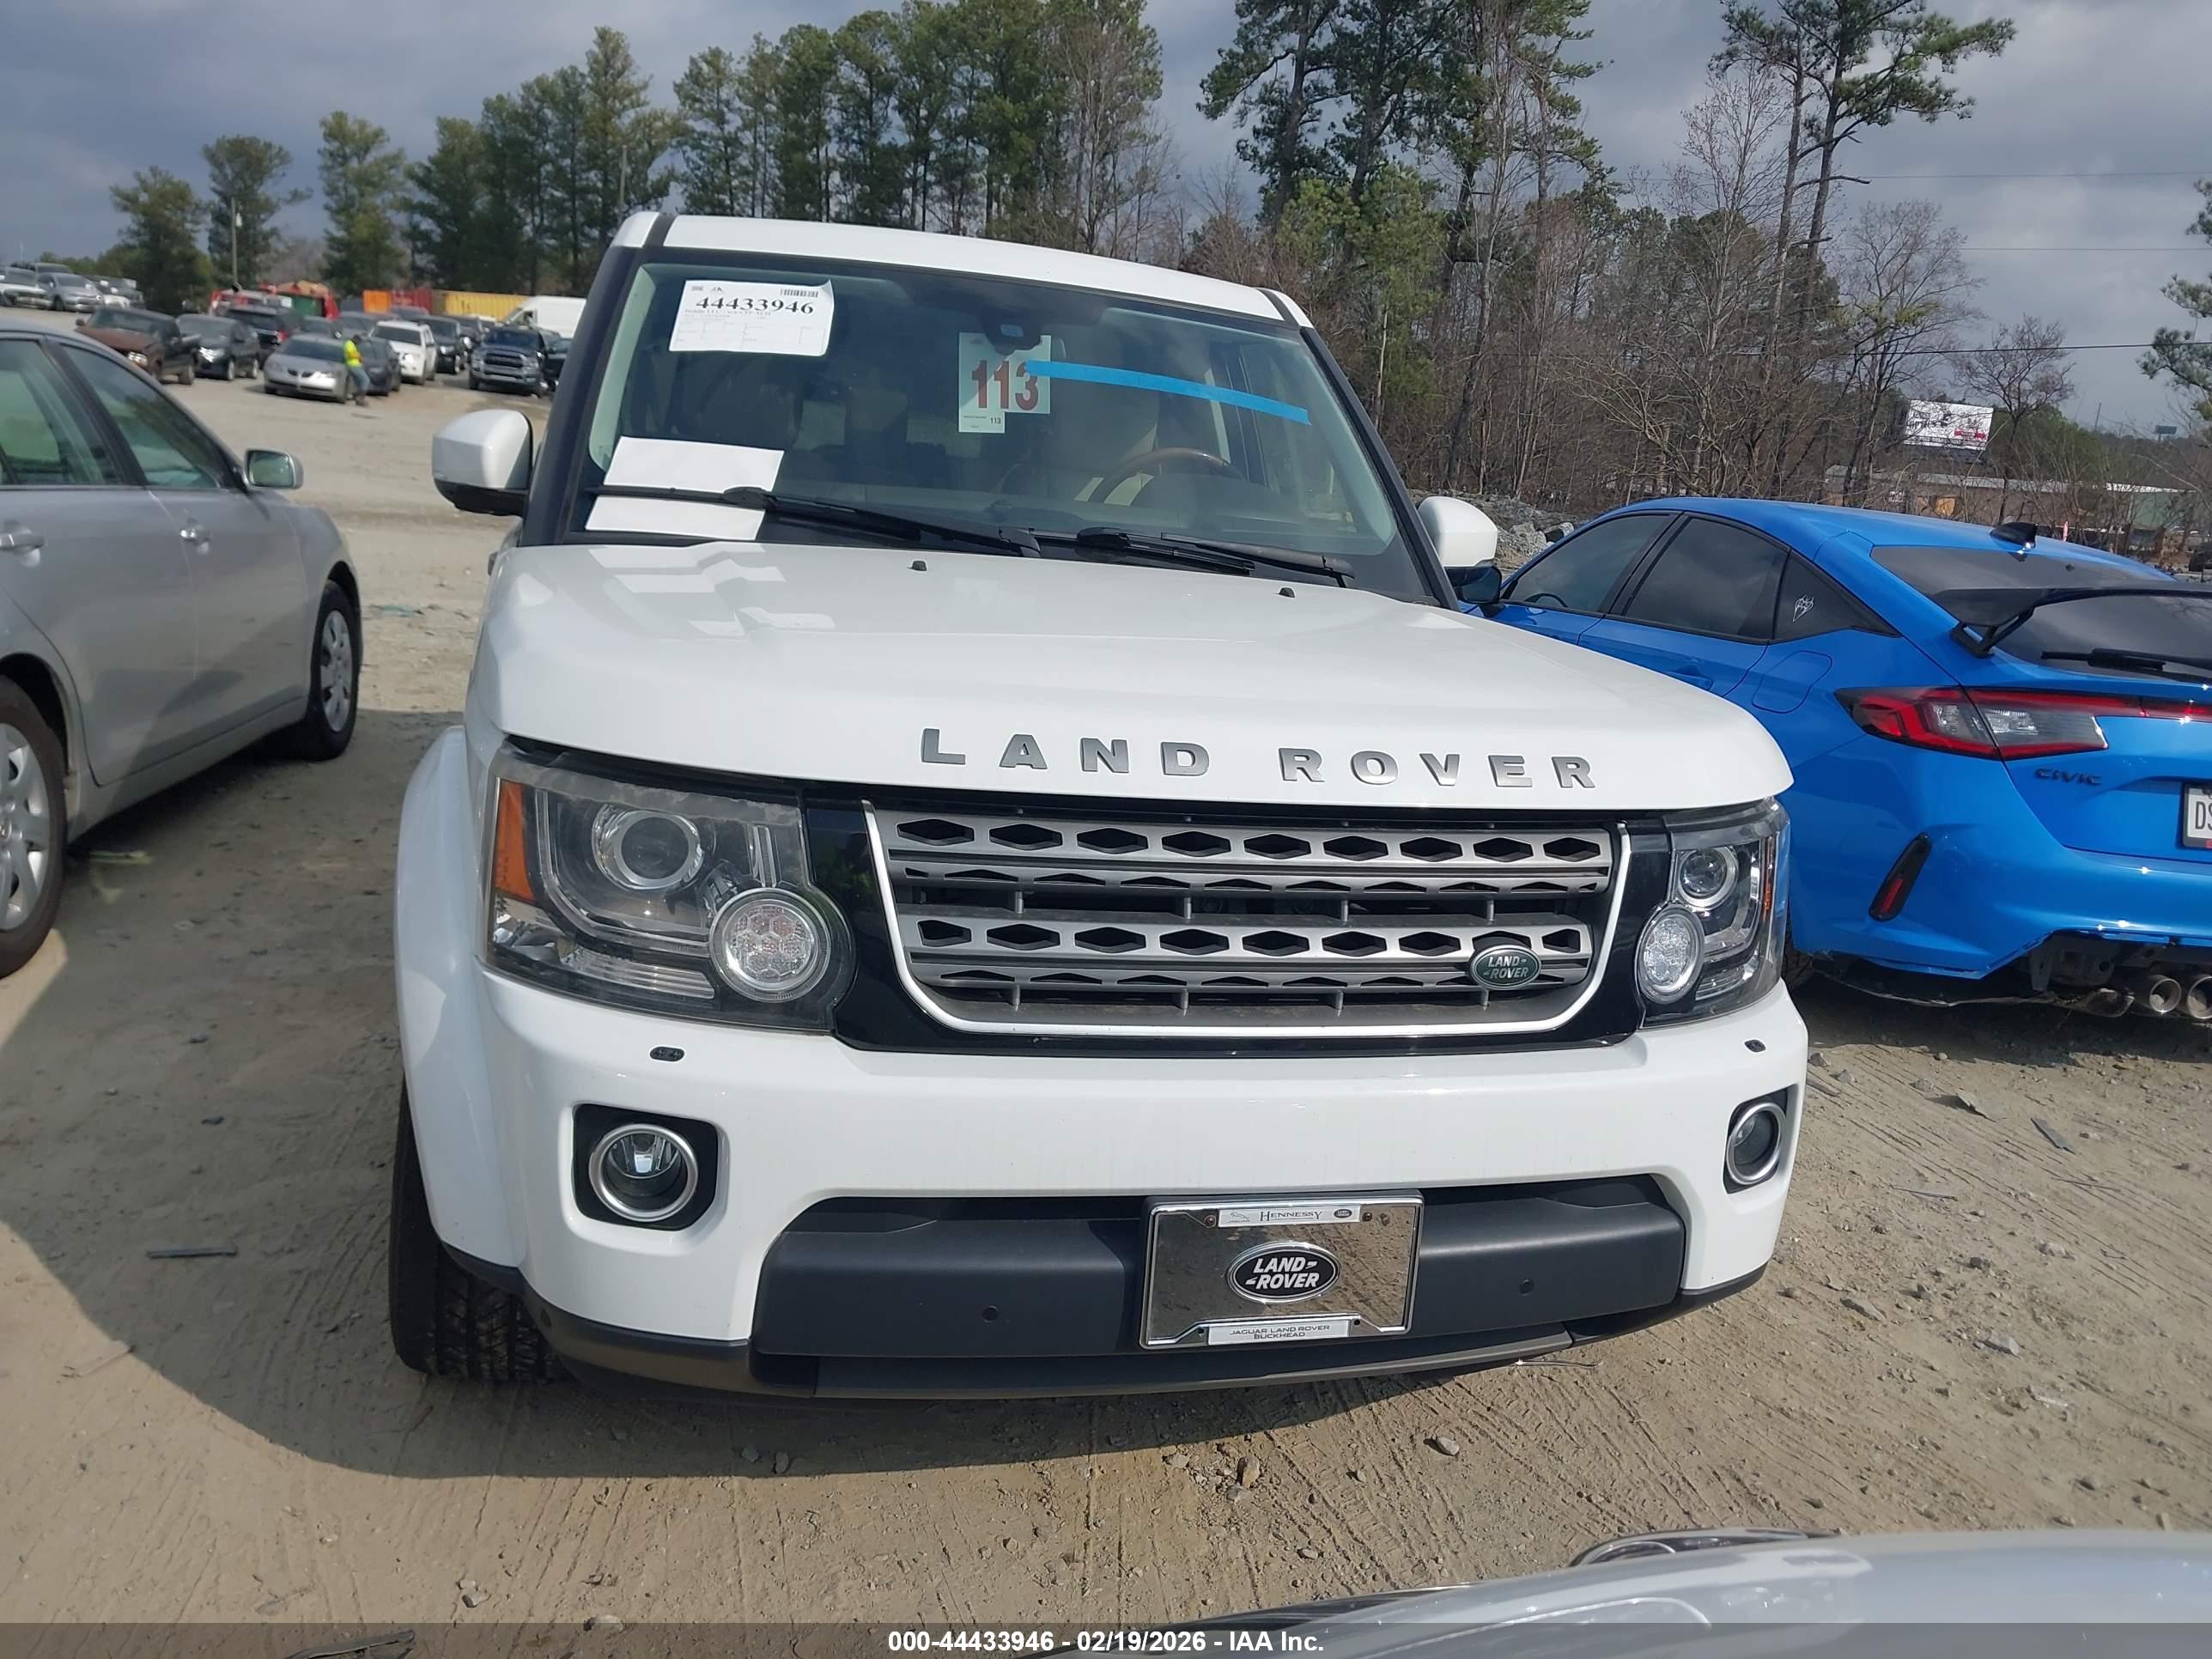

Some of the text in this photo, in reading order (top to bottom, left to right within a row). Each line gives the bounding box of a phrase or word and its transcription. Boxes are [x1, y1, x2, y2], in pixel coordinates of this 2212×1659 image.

[696, 296, 815, 315] 44433946
[971, 360, 1039, 411] 113
[921, 727, 1596, 788] LAND ROVER
[2034, 768, 2102, 787] CIVIC
[1488, 956, 1520, 967] LAND
[1490, 967, 1528, 978] ROVER
[1260, 1210, 1323, 1222] HENNESSY
[1253, 1256, 1306, 1273] LAND
[1255, 1272, 1320, 1290] ROVER
